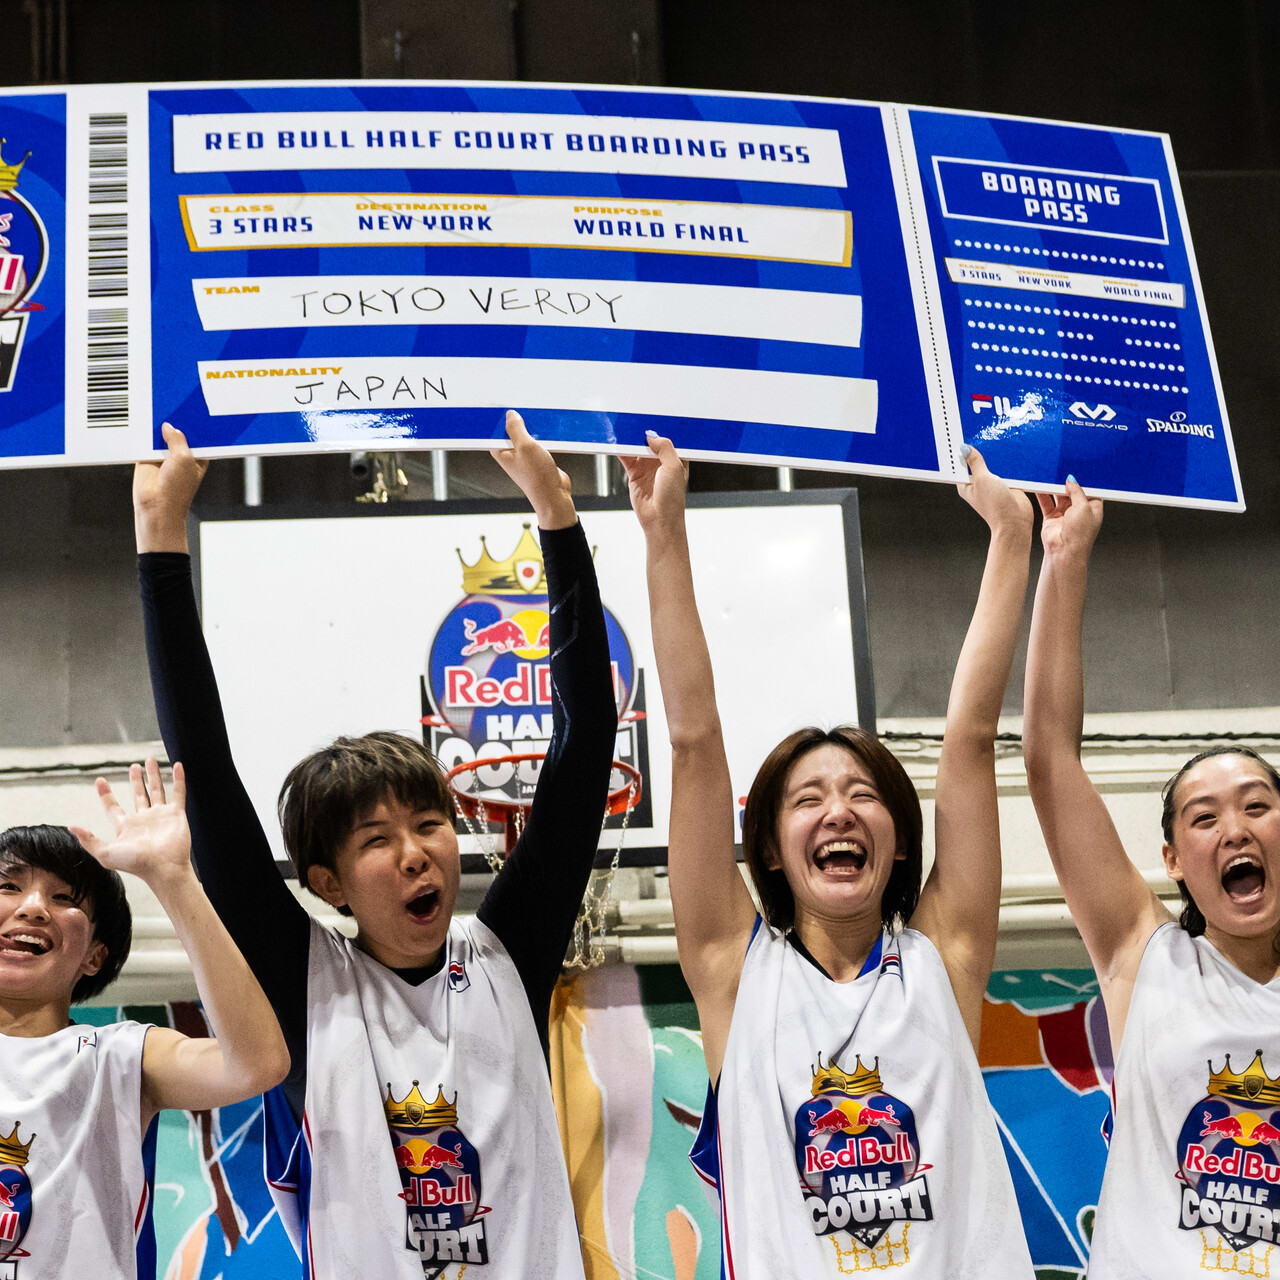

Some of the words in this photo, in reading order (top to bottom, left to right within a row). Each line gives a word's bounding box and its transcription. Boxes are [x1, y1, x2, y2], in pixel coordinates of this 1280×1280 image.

[204, 131, 264, 150] RED
[277, 130, 355, 148] BULL
[366, 130, 442, 148] HALF
[454, 130, 554, 150] COURT
[566, 133, 727, 159] BOARDING
[738, 141, 811, 164] PASS
[981, 171, 1121, 206] BOARDING
[209, 204, 275, 214] CLASS
[355, 202, 488, 212] DESTINATION
[573, 205, 664, 217] PURPOSE
[1023, 198, 1089, 224] PASS
[209, 218, 222, 235] 3
[234, 216, 314, 234] STARS
[358, 215, 413, 231] NEW
[422, 215, 493, 231] YORK
[573, 218, 666, 239] WORLD
[675, 223, 750, 244] FINAL
[203, 284, 260, 295] TEAM
[291, 286, 446, 318] TOKYO
[469, 287, 624, 323] VERDY
[205, 366, 344, 380] NATIONALITY
[293, 375, 449, 405] JAPAN
[1146, 417, 1215, 439] SPALDING
[447, 665, 531, 704] Red
[805, 1137, 857, 1173] Red
[859, 1132, 912, 1165] Bull
[1186, 1145, 1242, 1176] Red
[420, 1175, 473, 1206] Bull
[829, 1171, 892, 1194] HALF
[1206, 1181, 1270, 1205] HALF
[806, 1178, 927, 1235] COURT
